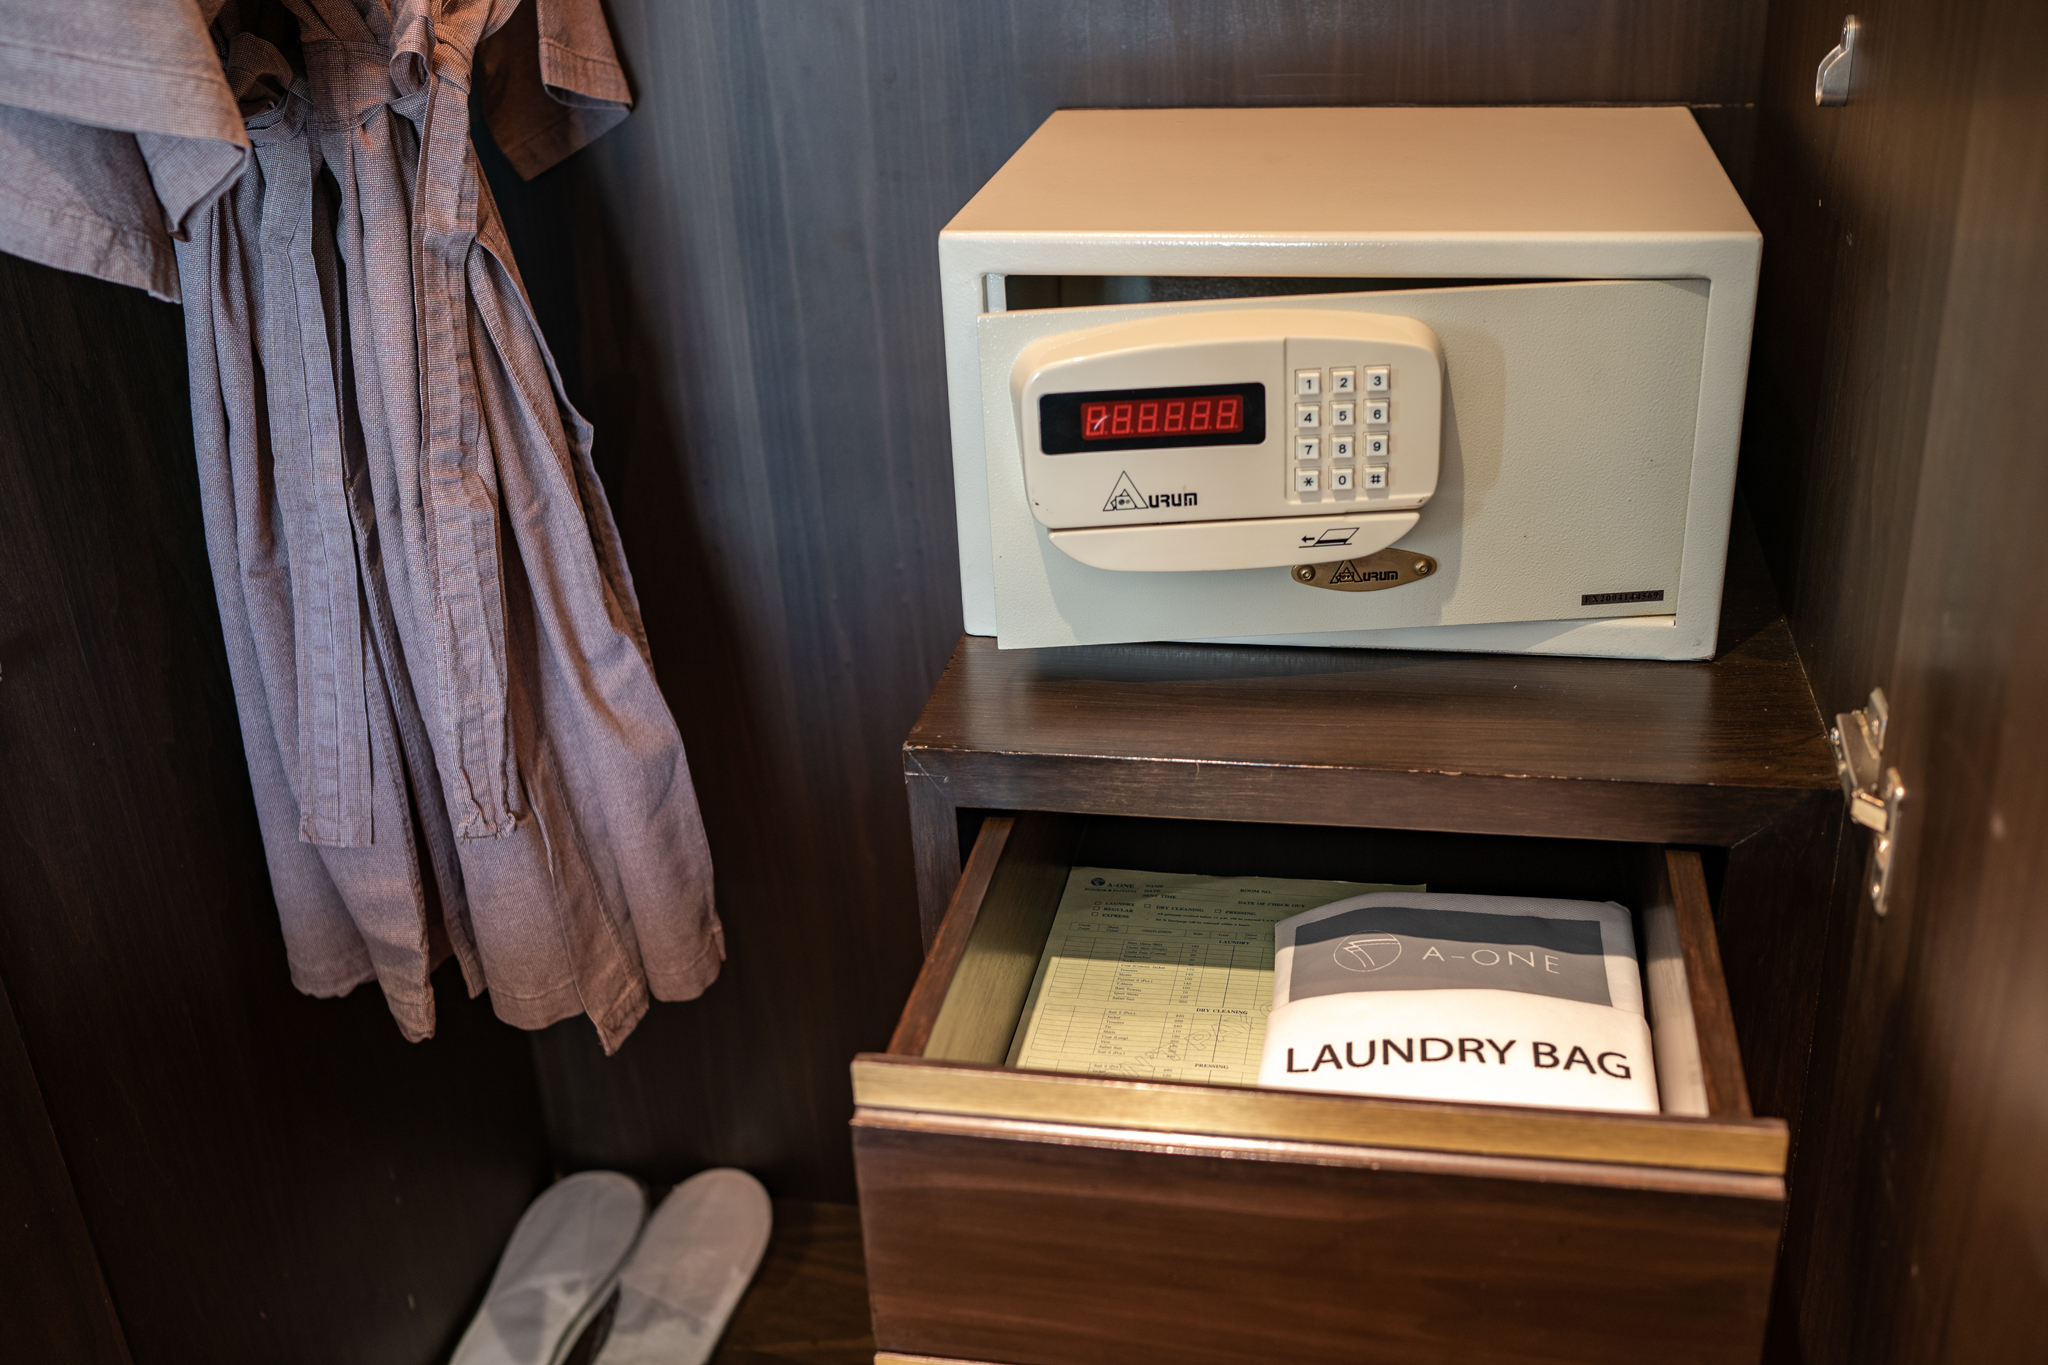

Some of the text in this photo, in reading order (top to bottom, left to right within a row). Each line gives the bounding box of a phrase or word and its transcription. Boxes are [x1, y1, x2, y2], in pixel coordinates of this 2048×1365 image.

[1306, 375, 1382, 390] 1 2 3
[1304, 409, 1382, 423] 4 5 6
[1304, 441, 1381, 455] 7 8 9
[1338, 475, 1347, 486] 0
[1422, 946, 1561, 975] A-ONE
[1286, 1038, 1632, 1080] LAUNDRY BAG
